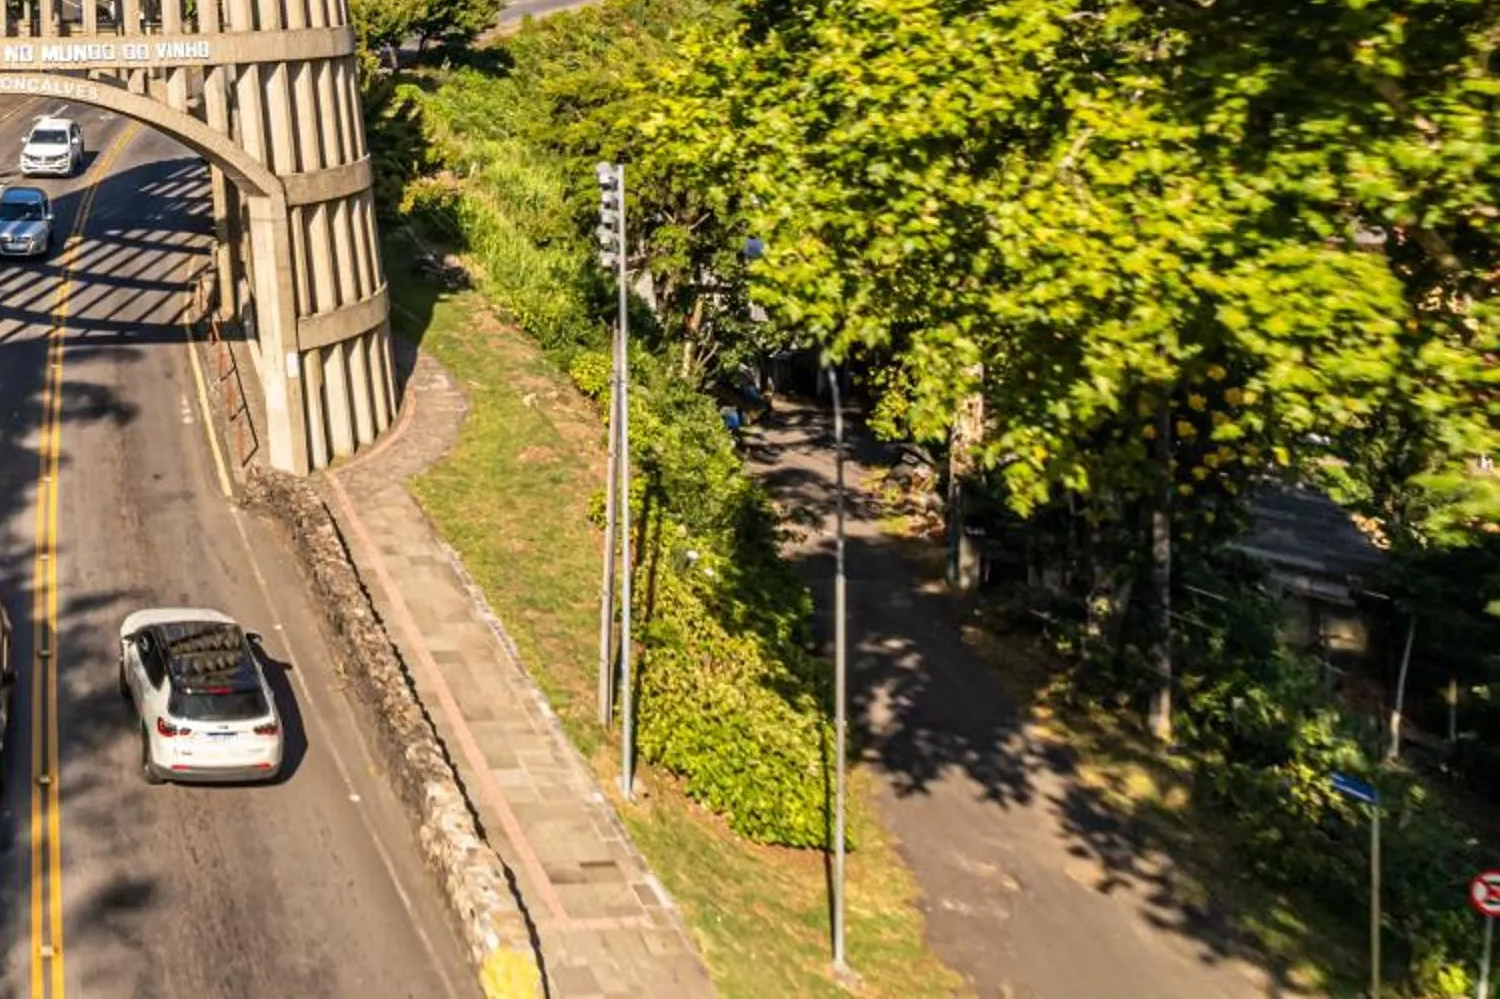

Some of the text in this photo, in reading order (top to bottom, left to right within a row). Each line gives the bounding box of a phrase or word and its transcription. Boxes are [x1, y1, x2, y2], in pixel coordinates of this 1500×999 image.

[4, 44, 33, 62] NO
[42, 44, 115, 62] MUNDO
[123, 44, 149, 60] DO
[156, 40, 209, 59] VINHO
